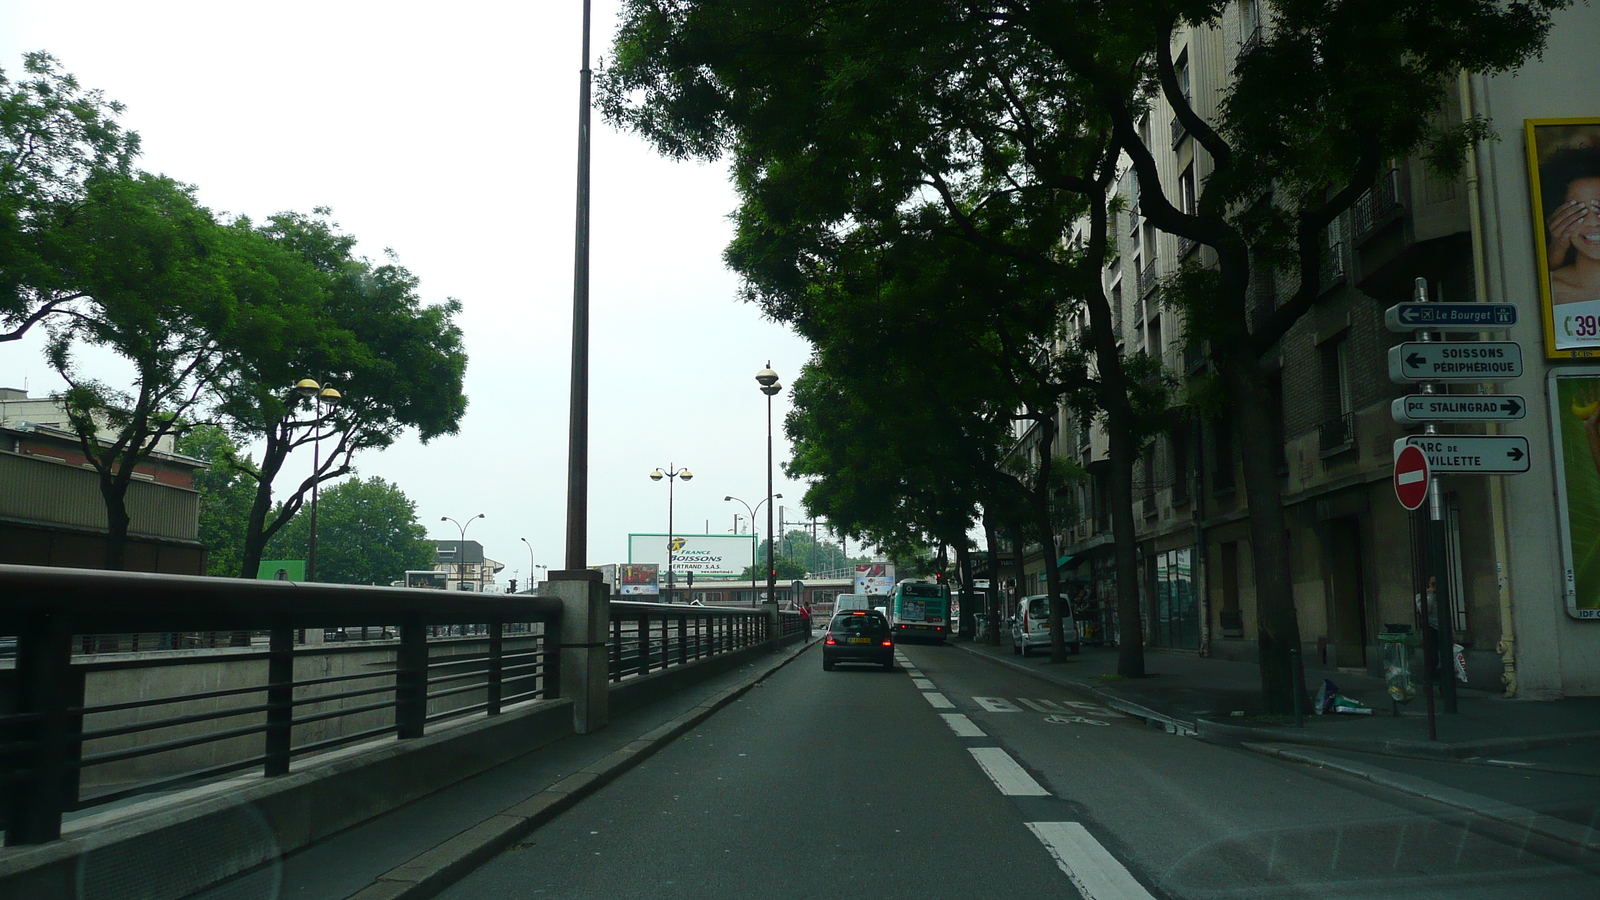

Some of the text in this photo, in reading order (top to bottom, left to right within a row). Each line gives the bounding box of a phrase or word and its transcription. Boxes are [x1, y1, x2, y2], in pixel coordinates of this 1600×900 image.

[1436, 309, 1491, 322] Le Bourget
[1575, 315, 1600, 337] 39
[1442, 348, 1504, 358] SOISSONS
[1433, 361, 1515, 373] PÉRIPHÉRIQUE
[1430, 402, 1498, 413] STALINGRAD
[1428, 456, 1481, 466] VILLETTE
[1579, 610, 1594, 618] IDF
[971, 696, 1127, 718] BUS
